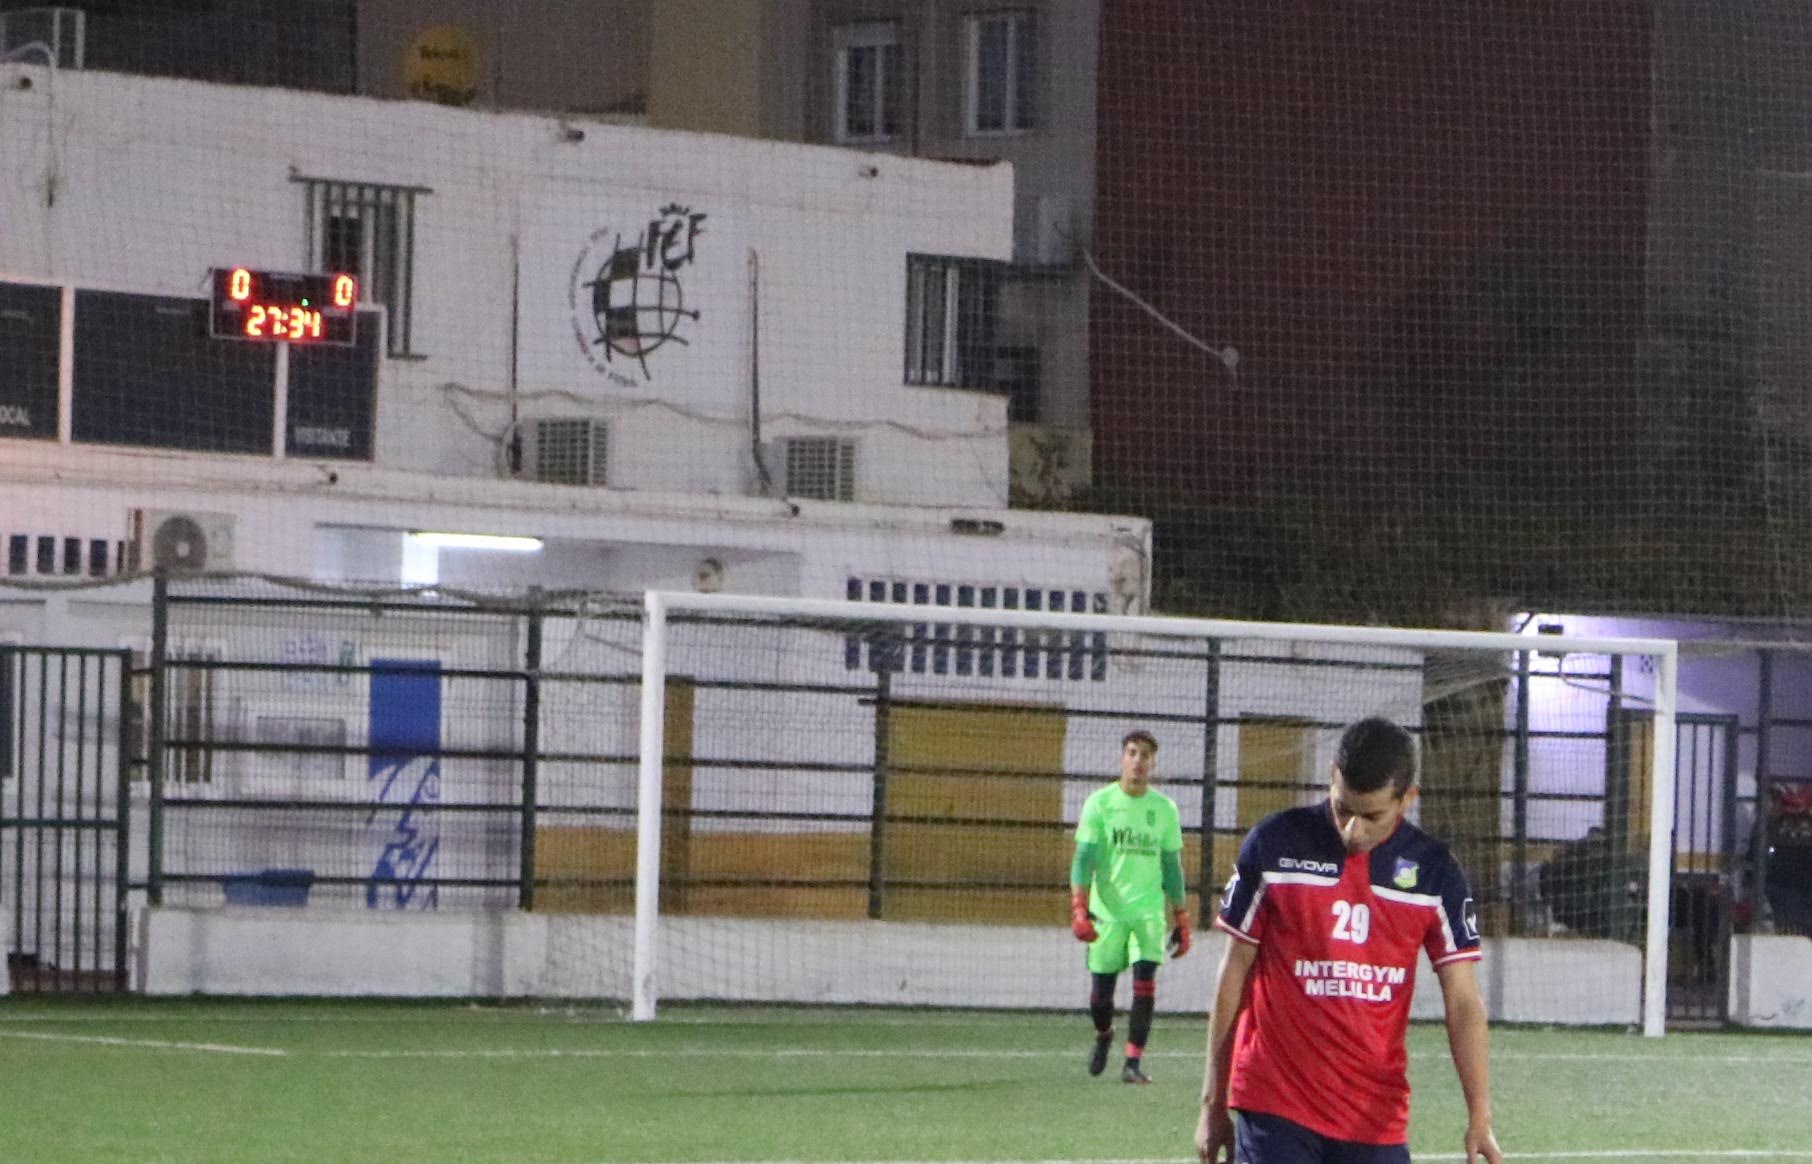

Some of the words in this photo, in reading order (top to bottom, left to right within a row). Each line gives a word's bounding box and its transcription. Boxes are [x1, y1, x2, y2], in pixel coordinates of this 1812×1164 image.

[231, 268, 250, 300] 0
[335, 275, 354, 306] 0
[247, 305, 321, 338] 27:34
[1278, 857, 1338, 873] GIVOVA
[1331, 899, 1370, 944] 29
[1294, 959, 1406, 983] INTERGYM
[1305, 979, 1392, 1002] MELILLA
